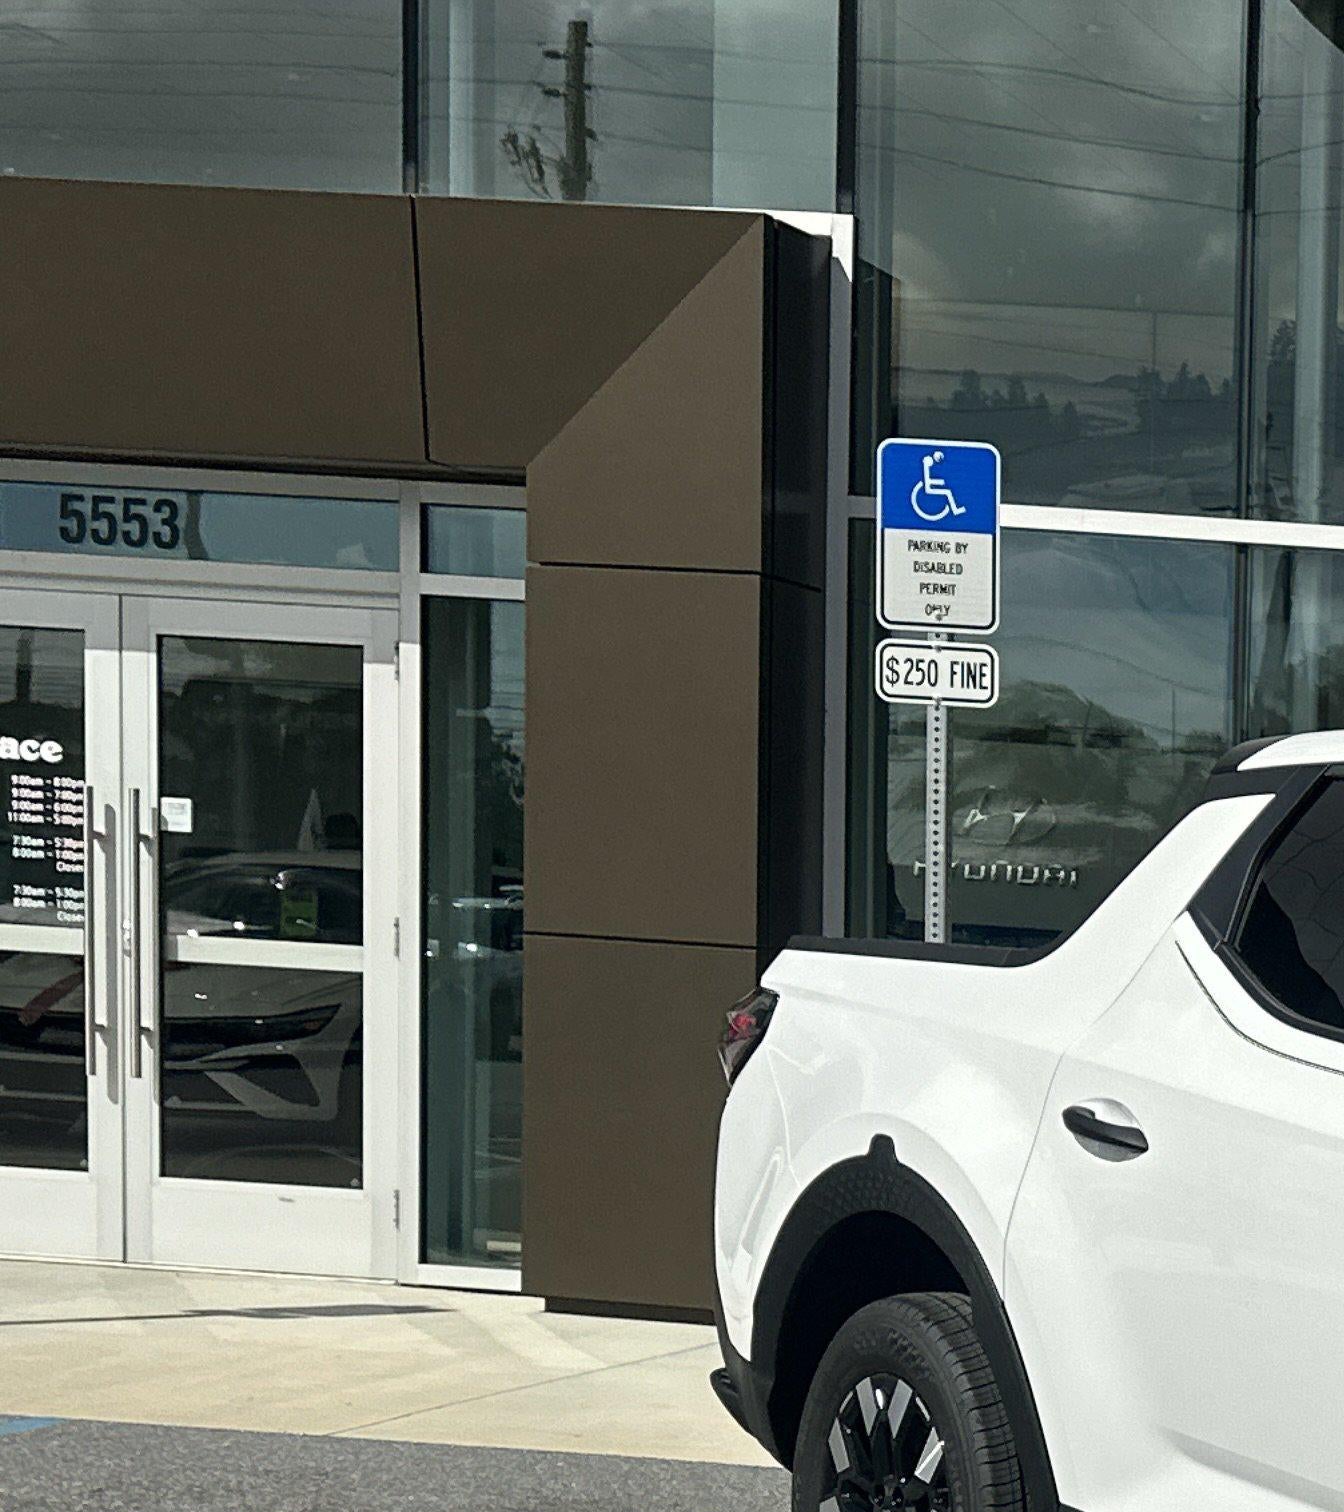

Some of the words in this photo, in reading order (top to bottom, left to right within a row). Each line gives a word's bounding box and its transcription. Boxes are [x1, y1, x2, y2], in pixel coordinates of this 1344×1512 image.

[58, 493, 181, 550] 5553
[907, 539, 951, 554] PARKING
[954, 542, 969, 555] BY
[912, 560, 964, 576] DISABLED
[919, 582, 957, 596] PERMIT
[885, 655, 939, 688] $250
[949, 660, 989, 690] FINE
